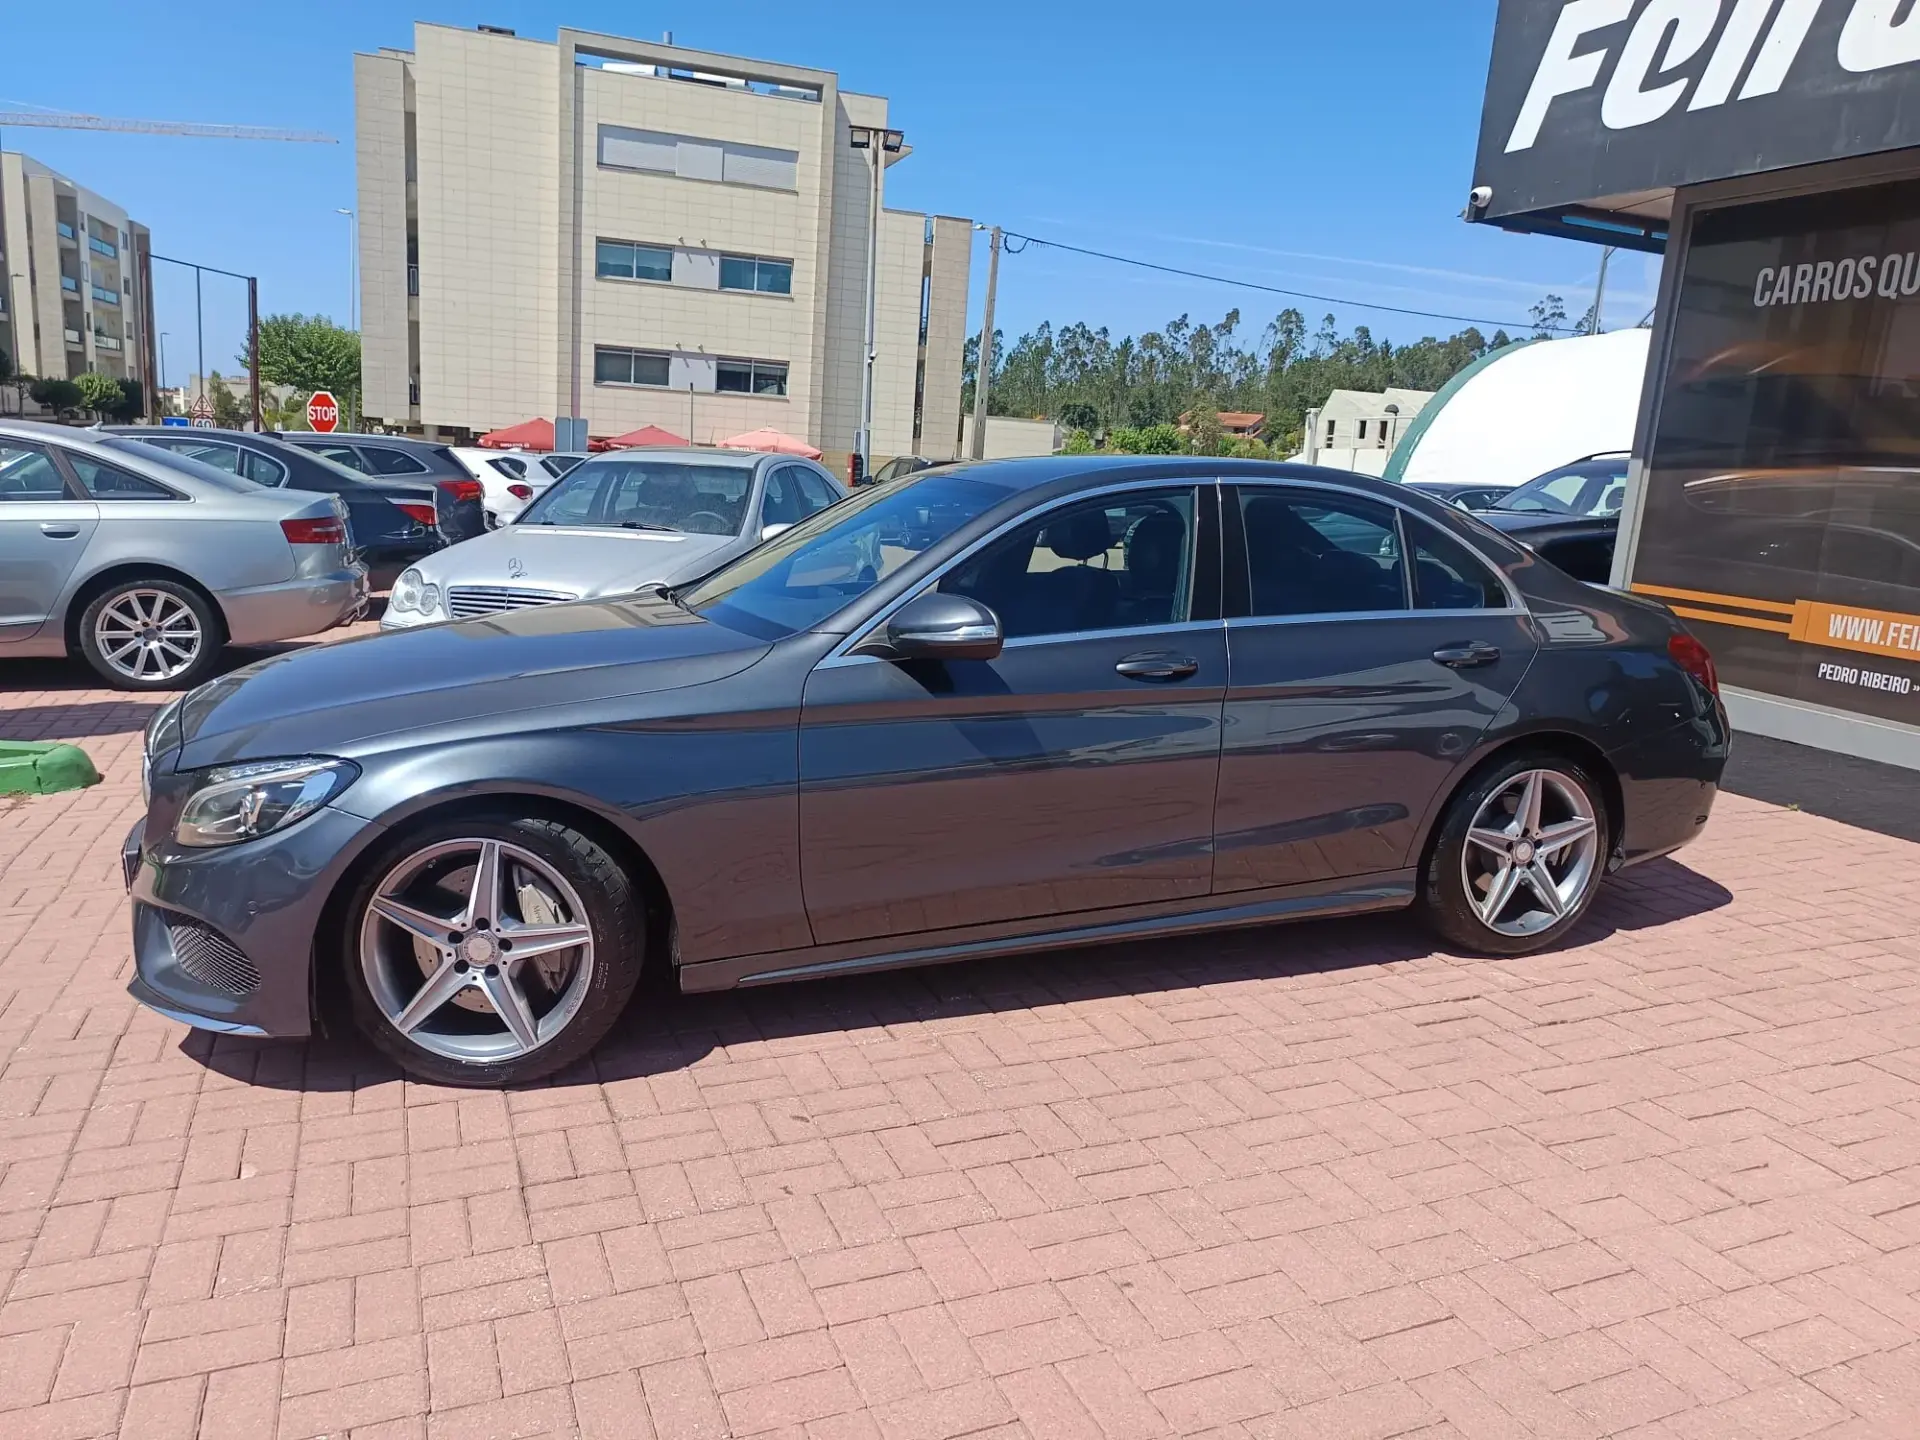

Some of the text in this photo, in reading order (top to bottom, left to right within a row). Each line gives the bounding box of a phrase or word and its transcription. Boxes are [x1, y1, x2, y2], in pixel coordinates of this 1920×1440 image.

[1753, 256, 1877, 307] CARROS
[309, 405, 336, 421] STOP
[1817, 662, 1858, 684] PEDRO
[1860, 670, 1911, 694] RIBEIRO
